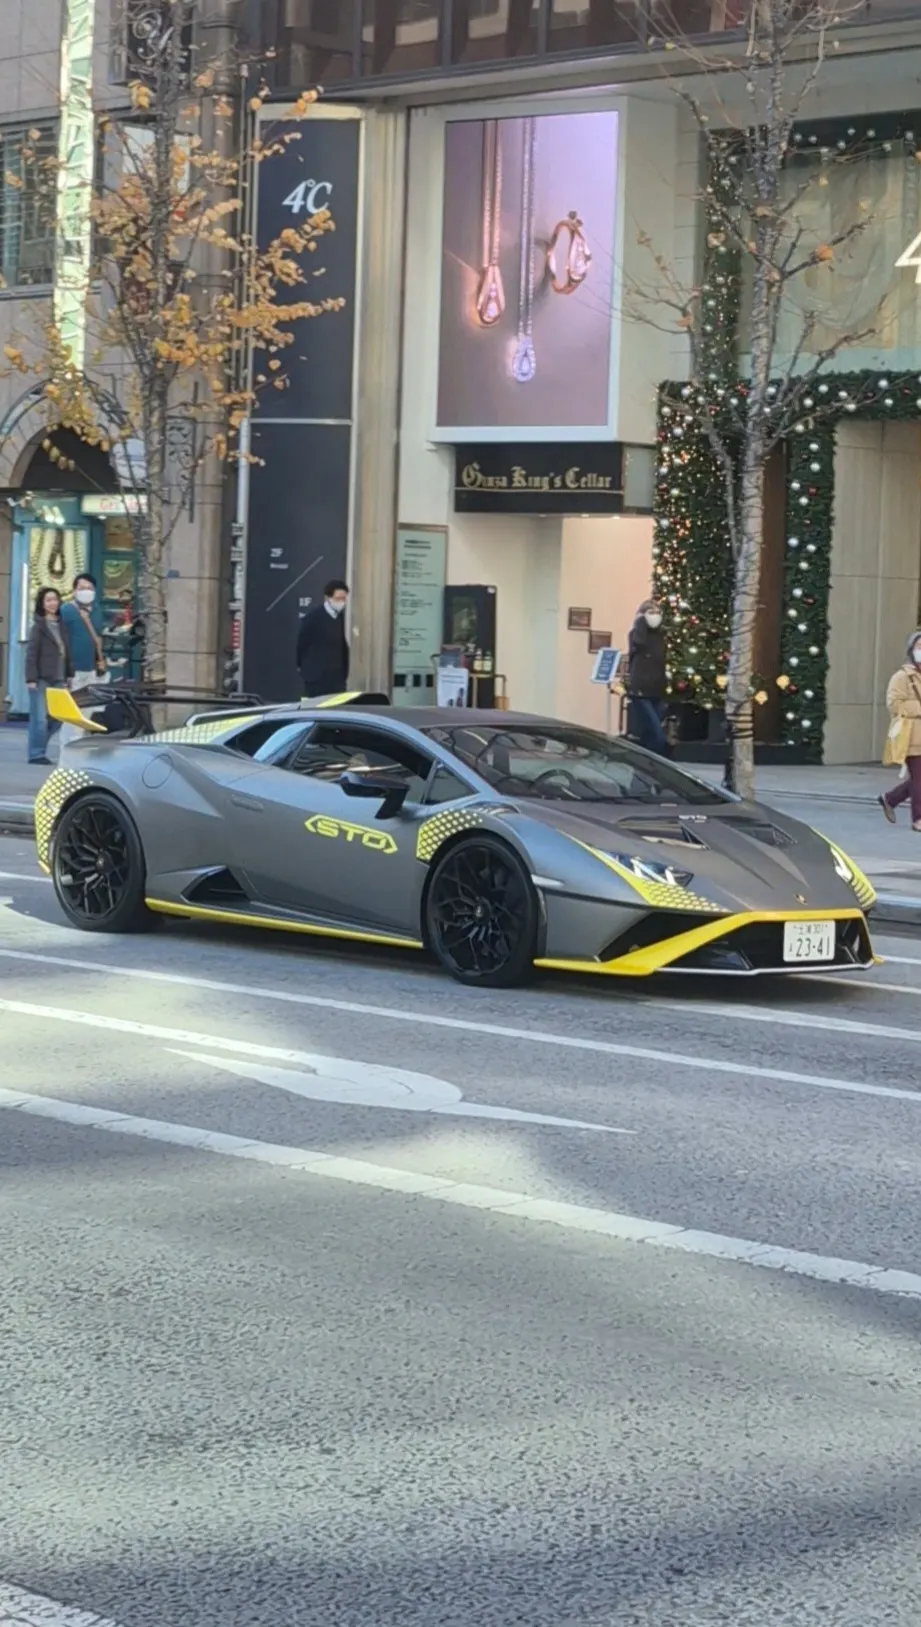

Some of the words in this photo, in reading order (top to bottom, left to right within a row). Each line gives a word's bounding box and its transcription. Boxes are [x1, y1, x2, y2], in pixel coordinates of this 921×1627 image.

[461, 462, 508, 488] Ginza
[510, 466, 562, 491] King's
[564, 466, 613, 489] Cellar
[313, 818, 388, 850] STO
